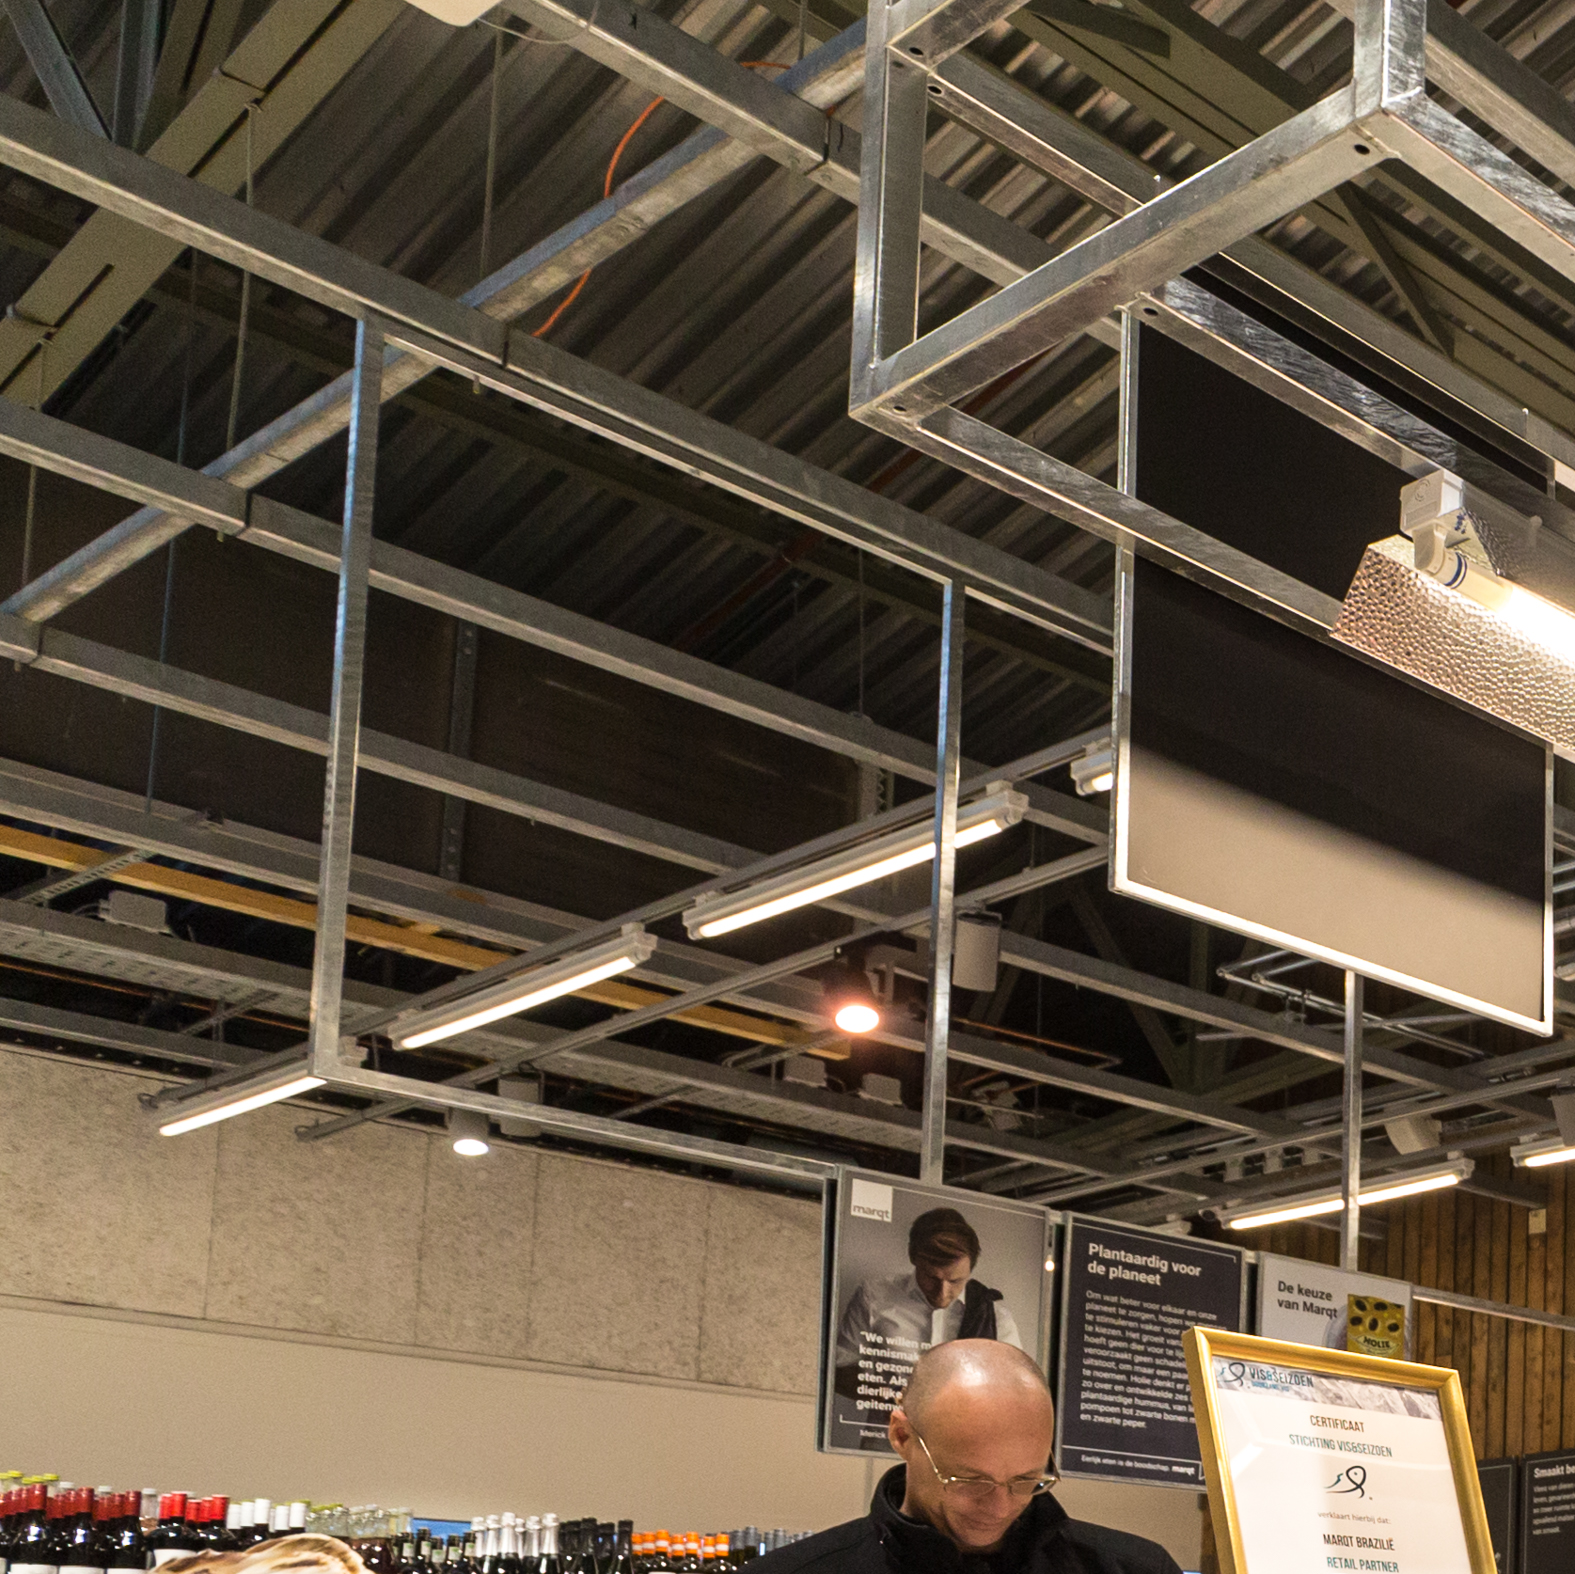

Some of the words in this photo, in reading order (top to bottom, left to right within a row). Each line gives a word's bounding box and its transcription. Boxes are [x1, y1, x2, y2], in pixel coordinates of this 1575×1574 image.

[852, 1203, 890, 1221] marqt
[1088, 1242, 1169, 1274] Plantaardig
[1171, 1261, 1202, 1277] voor
[1087, 1260, 1106, 1276] de
[1108, 1265, 1161, 1287] planeet
[1278, 1280, 1294, 1294] De
[1297, 1283, 1333, 1301] keuze
[1277, 1298, 1299, 1311] van
[1302, 1301, 1338, 1320] Marqt
[885, 1335, 918, 1349] willen
[1363, 1336, 1391, 1349] HOLIE
[859, 1344, 920, 1363] kennismak
[858, 1359, 873, 1370] en
[857, 1371, 887, 1385] eten.
[889, 1374, 908, 1388] Als
[1249, 1366, 1314, 1388] VIS&SEIZOEN
[857, 1384, 903, 1401] dierlijke
[1310, 1414, 1364, 1433] CERTIFICAAT
[1289, 1433, 1335, 1451] STICHTING
[1337, 1439, 1393, 1458] VIS&SEIZOEN
[1533, 1464, 1565, 1479] Smaakt
[1317, 1511, 1350, 1521] verklaart
[1352, 1513, 1375, 1525] hierbij
[1377, 1515, 1391, 1525] dat:
[1323, 1533, 1354, 1549] MARQT
[1356, 1536, 1395, 1551] BRAZILIË
[1326, 1556, 1358, 1570] RETAIL
[1359, 1559, 1399, 1573] PARTNER
